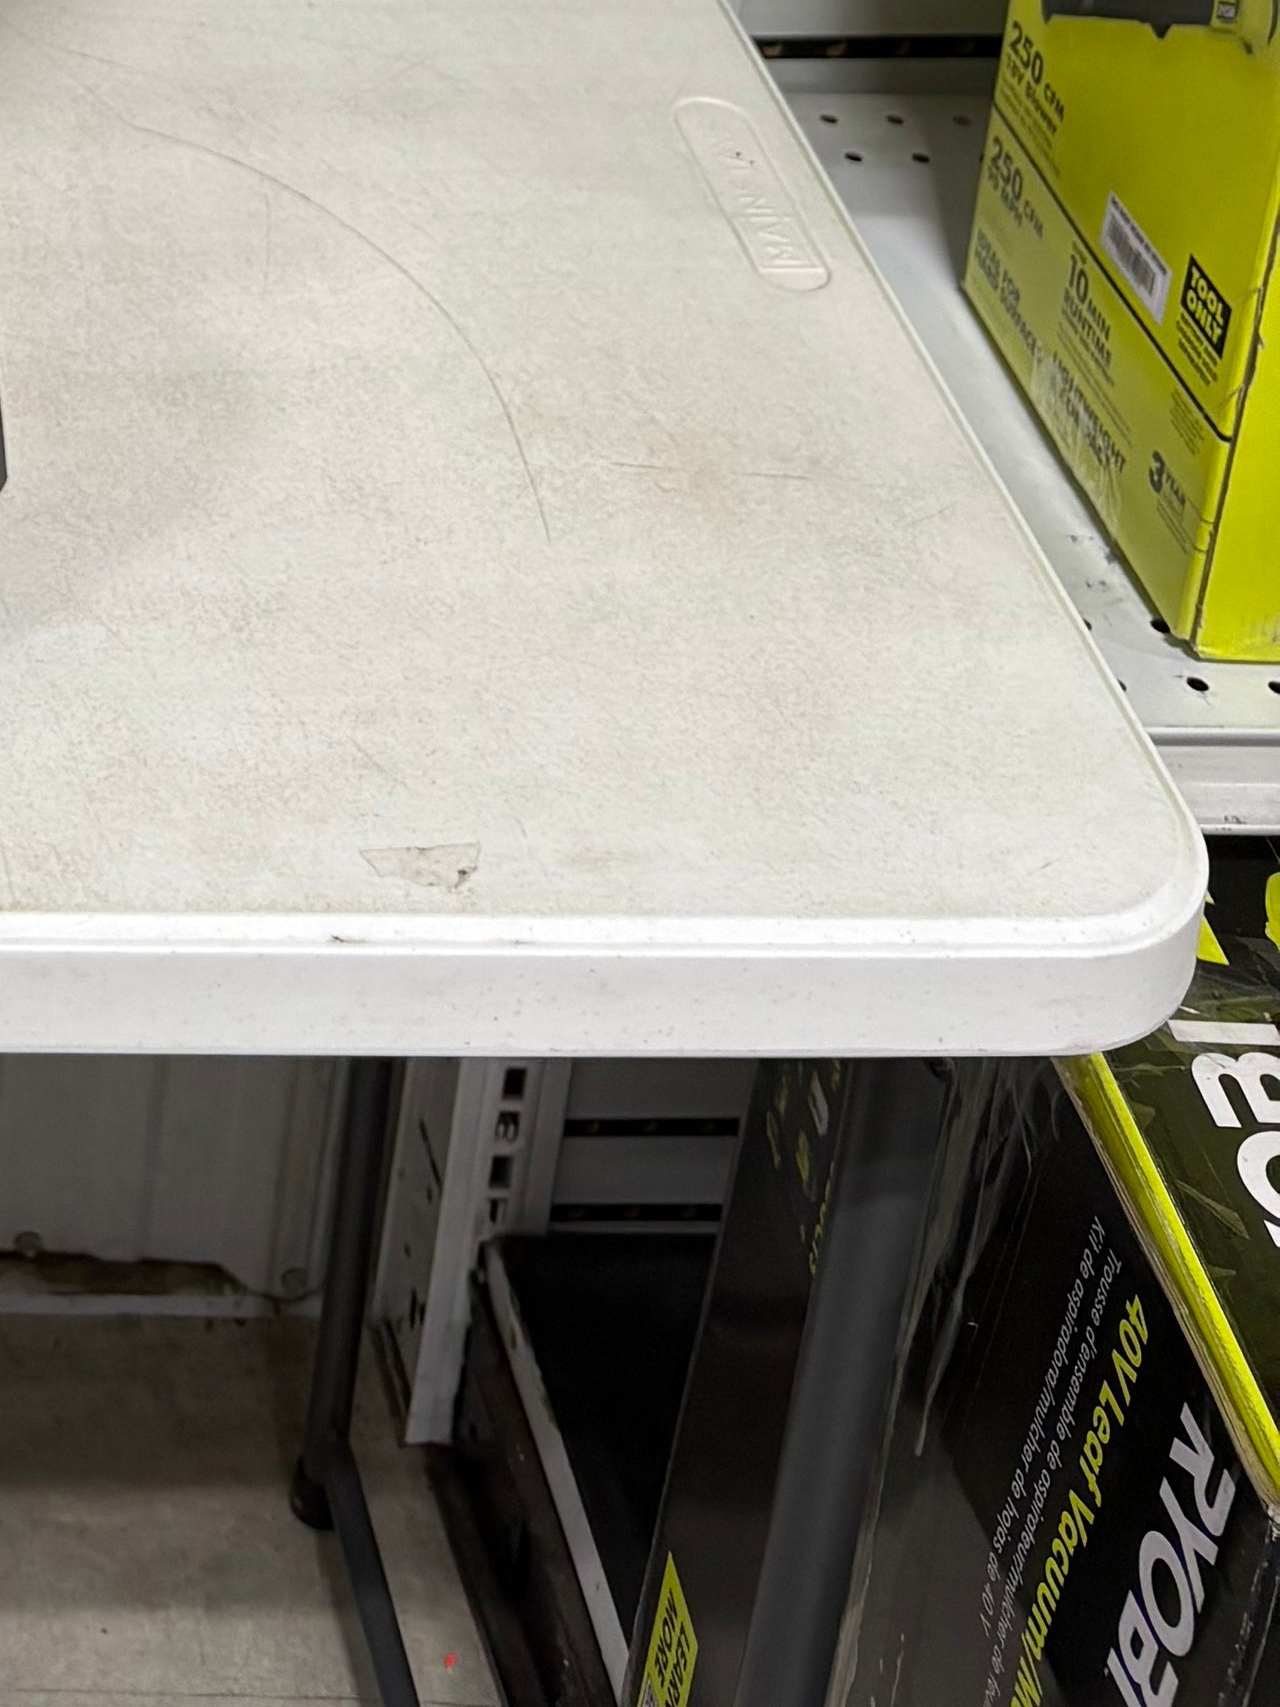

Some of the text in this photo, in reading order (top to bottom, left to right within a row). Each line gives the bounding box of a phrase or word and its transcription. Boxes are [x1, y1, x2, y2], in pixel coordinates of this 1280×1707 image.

[1009, 19, 1044, 86] 250
[990, 134, 1024, 203] 250
[1068, 253, 1089, 306] 10
[1190, 264, 1224, 327] TOOL
[1186, 288, 1222, 347] ONLY
[1088, 1215, 1106, 1255] Kit
[1079, 1247, 1096, 1280] de
[1091, 1248, 1123, 1328] Trousse
[1046, 1440, 1063, 1469] de
[1010, 1294, 1149, 1707] 40V Leaf Vacuum/M
[1011, 1468, 1026, 1500] de
[992, 1493, 1020, 1555] hojas
[987, 1551, 1001, 1581] de
[979, 1610, 992, 1638] V
[981, 1582, 995, 1617] 40
[654, 1587, 679, 1689] MORE
[991, 1644, 1005, 1675] de
